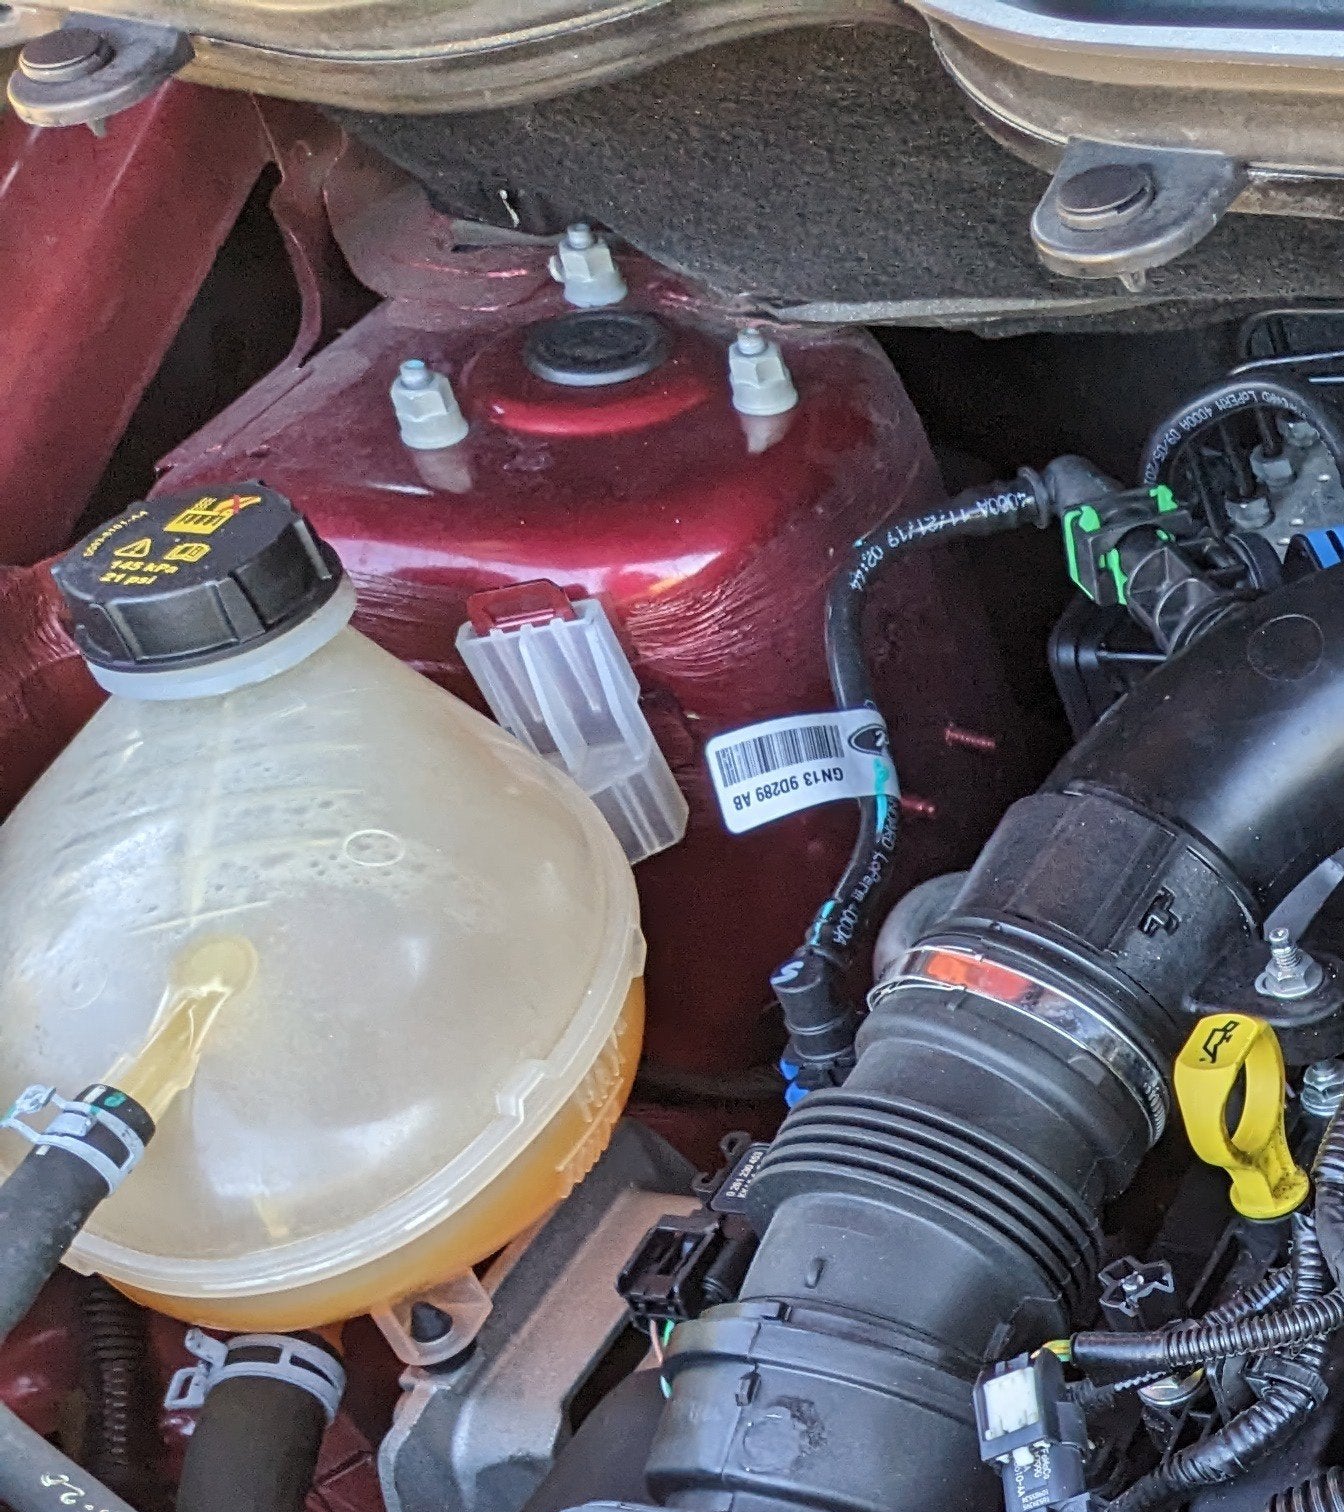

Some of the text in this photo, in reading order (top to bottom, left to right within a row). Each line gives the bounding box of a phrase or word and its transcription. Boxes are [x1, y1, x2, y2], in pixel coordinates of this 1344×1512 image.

[100, 572, 158, 585] 21 psi
[732, 766, 845, 811] GN13 9D289 AB
